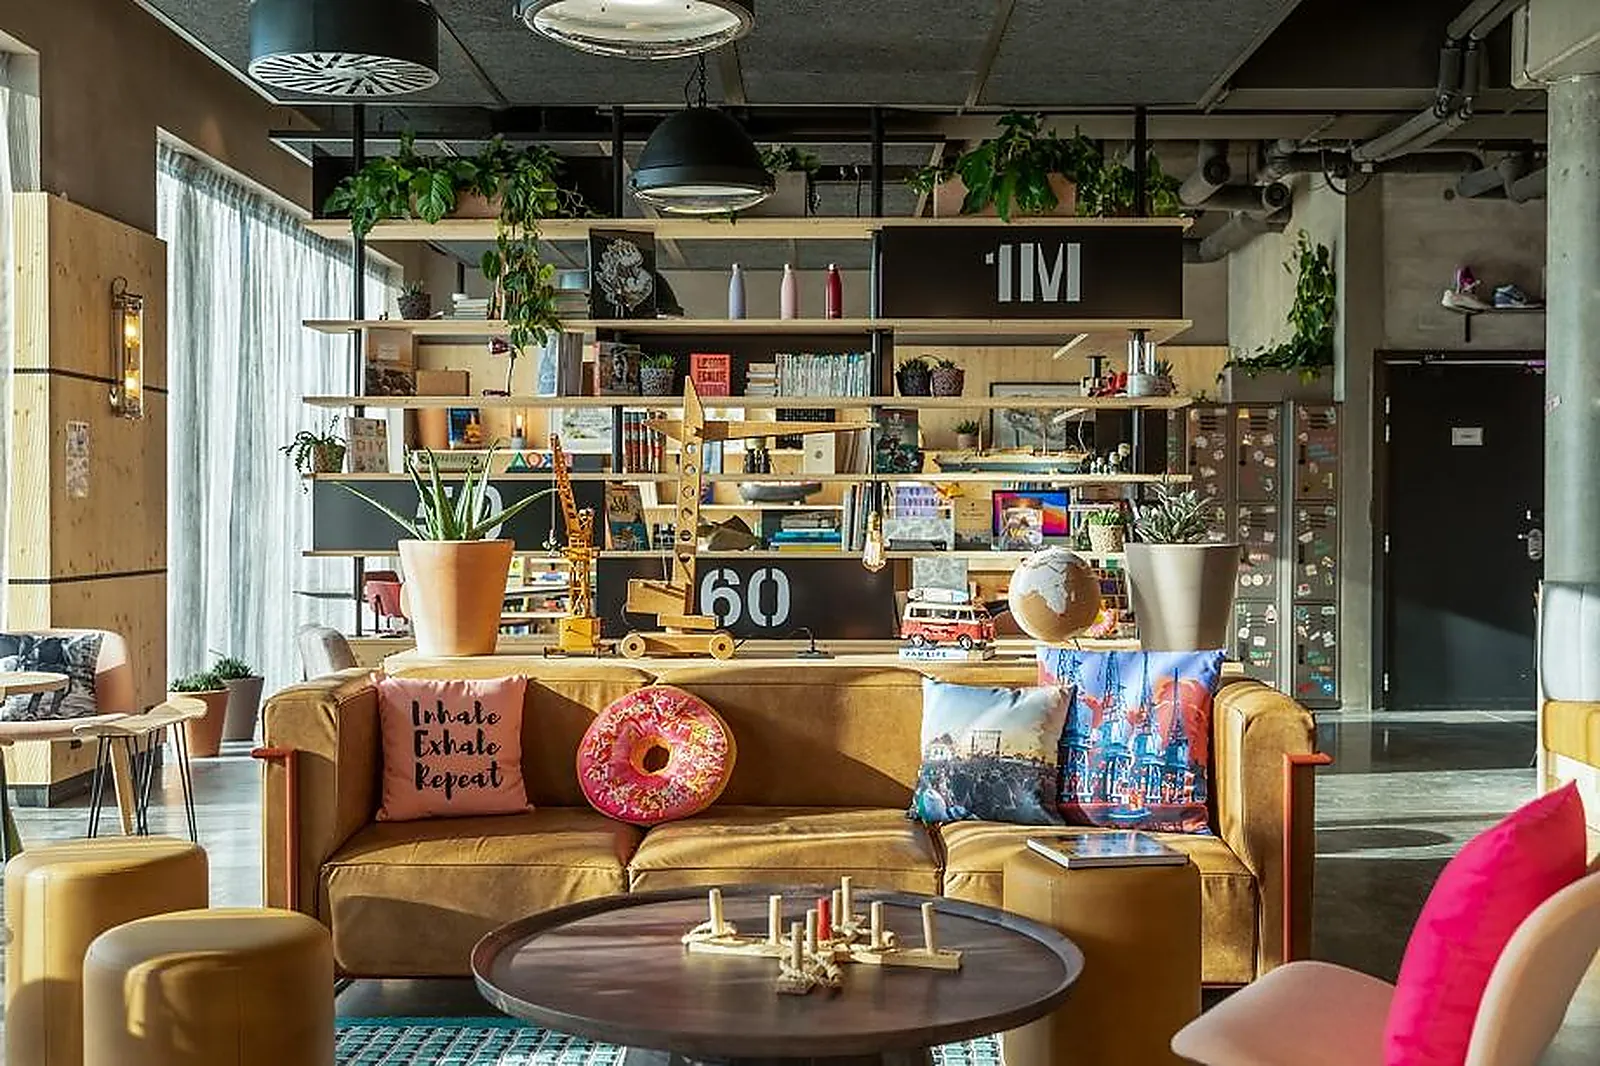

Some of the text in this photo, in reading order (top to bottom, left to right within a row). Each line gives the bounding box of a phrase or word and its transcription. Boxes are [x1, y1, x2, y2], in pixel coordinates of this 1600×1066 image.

[985, 242, 1081, 302] 1M
[355, 439, 384, 453] DIY
[700, 567, 791, 628] 60
[410, 699, 503, 727] Inhale
[412, 728, 503, 757] Exhale
[414, 760, 504, 800] Repeat
